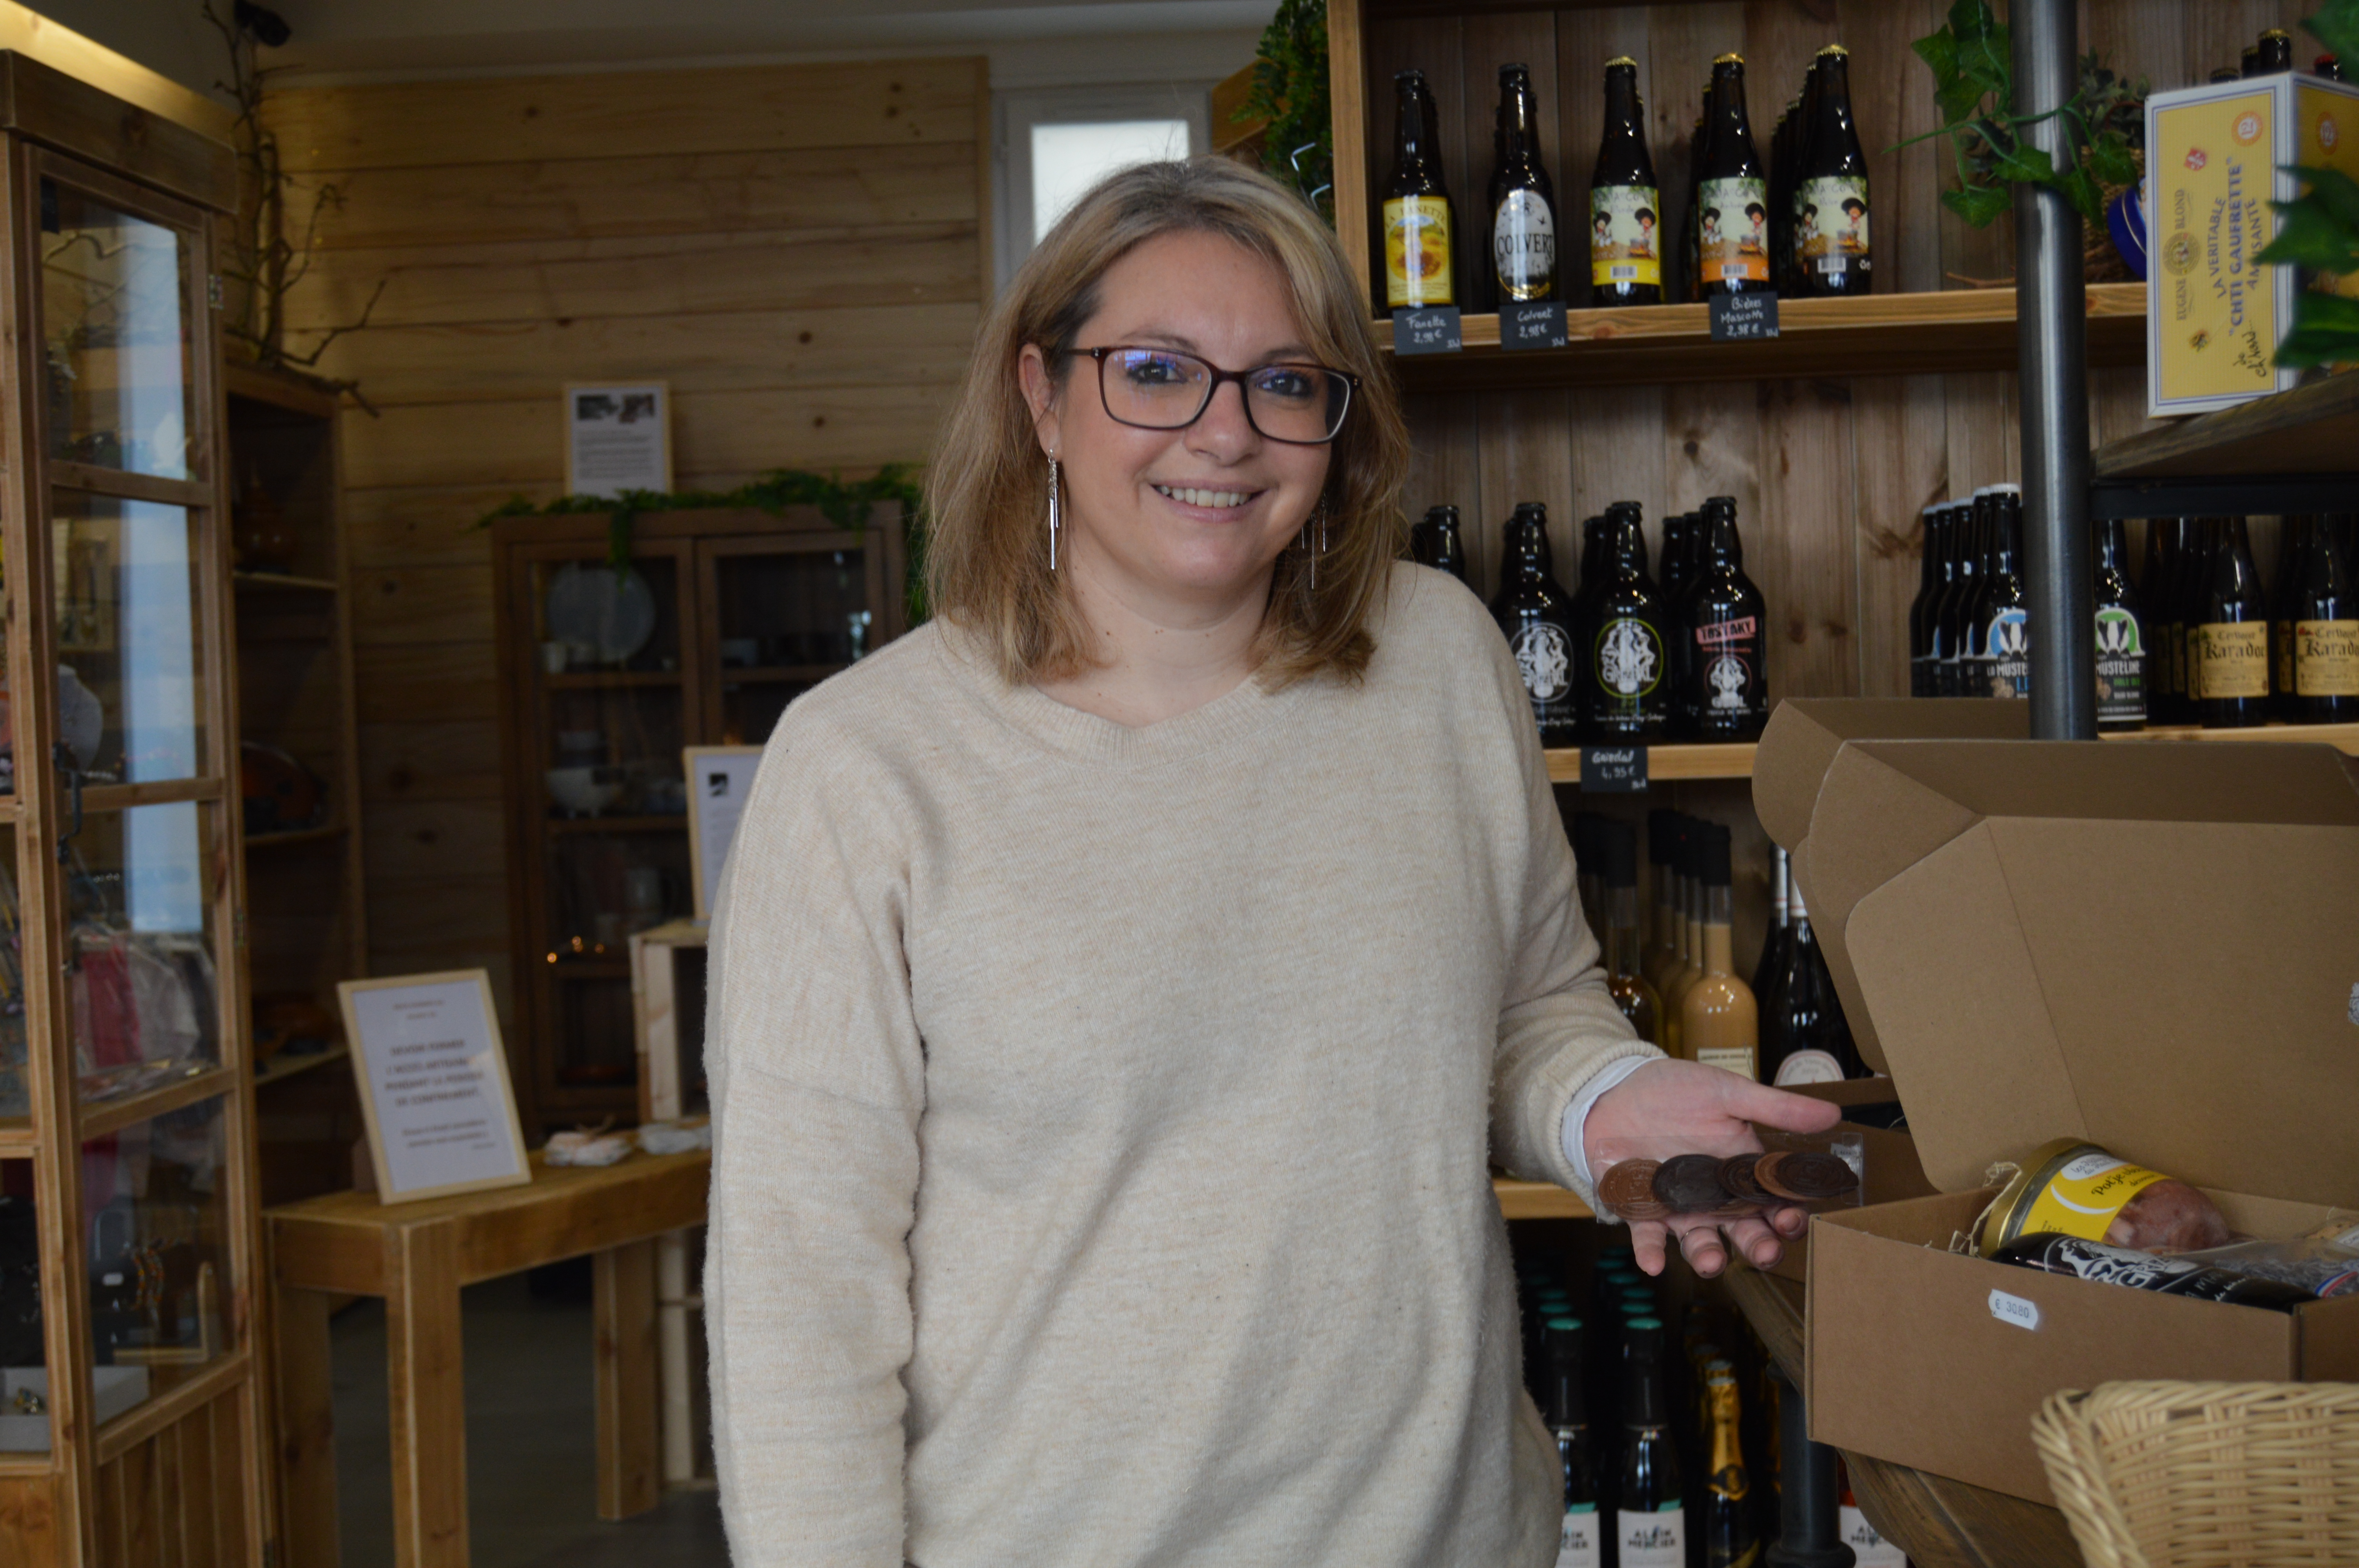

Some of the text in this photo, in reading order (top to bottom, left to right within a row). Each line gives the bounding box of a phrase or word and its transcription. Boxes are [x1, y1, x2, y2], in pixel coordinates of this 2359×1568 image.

[1496, 233, 1553, 256] COLVERT
[2175, 188, 2186, 321] EUGENE BLOND
[2208, 197, 2226, 298] LA VERITABLE
[2246, 198, 2262, 290] AMSANTE
[1995, 1298, 2000, 1310] €
